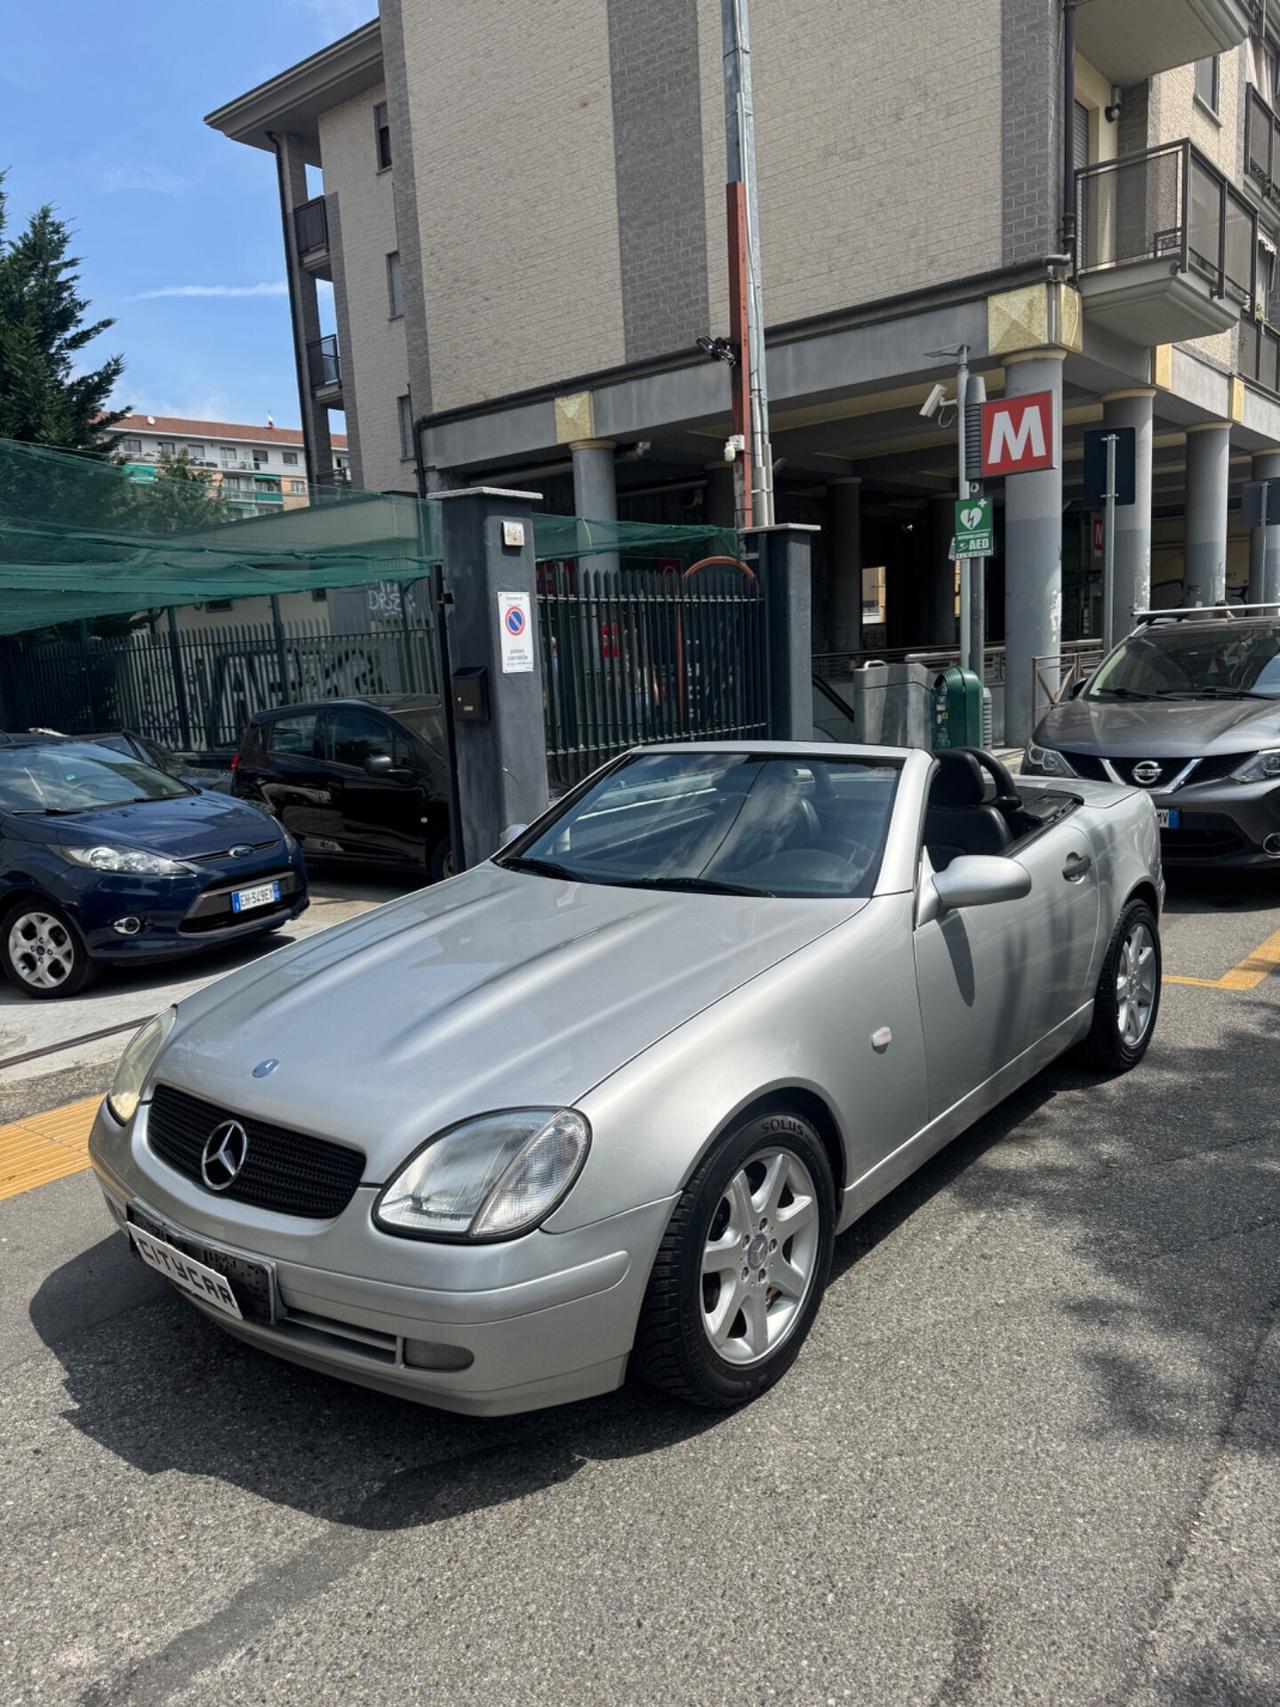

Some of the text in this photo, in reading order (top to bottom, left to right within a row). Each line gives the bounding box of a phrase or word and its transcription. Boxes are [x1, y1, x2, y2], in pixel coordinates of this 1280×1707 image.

[988, 406, 1047, 465] M
[969, 539, 989, 550] AED
[761, 1119, 804, 1135] SOLUS
[137, 1237, 236, 1309] CITYCAR
